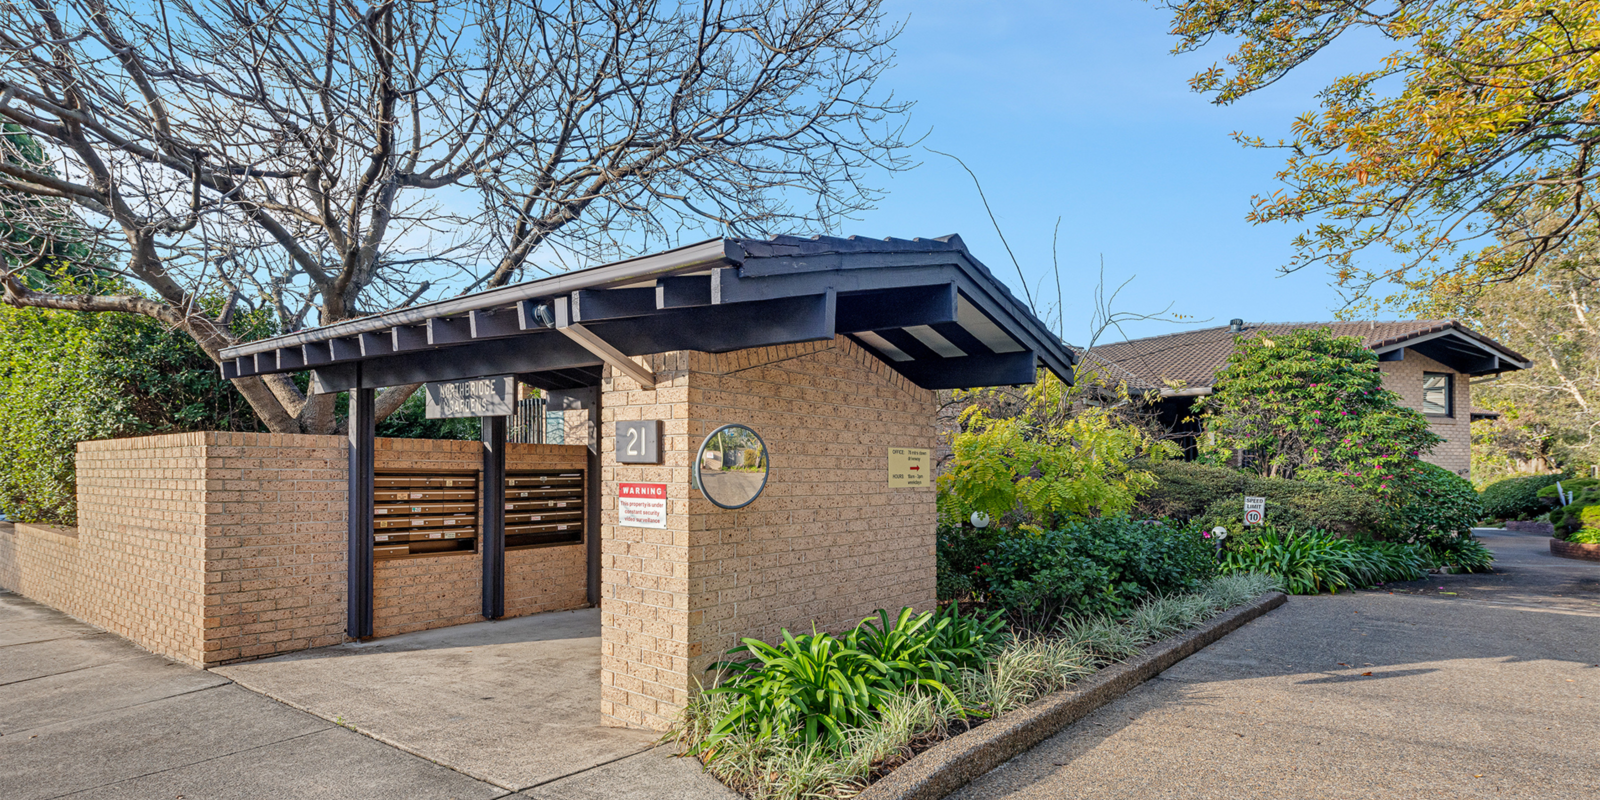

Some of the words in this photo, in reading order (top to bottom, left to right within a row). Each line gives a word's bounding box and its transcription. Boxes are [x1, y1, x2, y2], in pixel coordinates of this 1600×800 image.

[440, 379, 496, 398] NORTHBRIDGE
[448, 398, 487, 414] GARDENS
[627, 426, 646, 456] 21
[622, 486, 662, 495] WARNING
